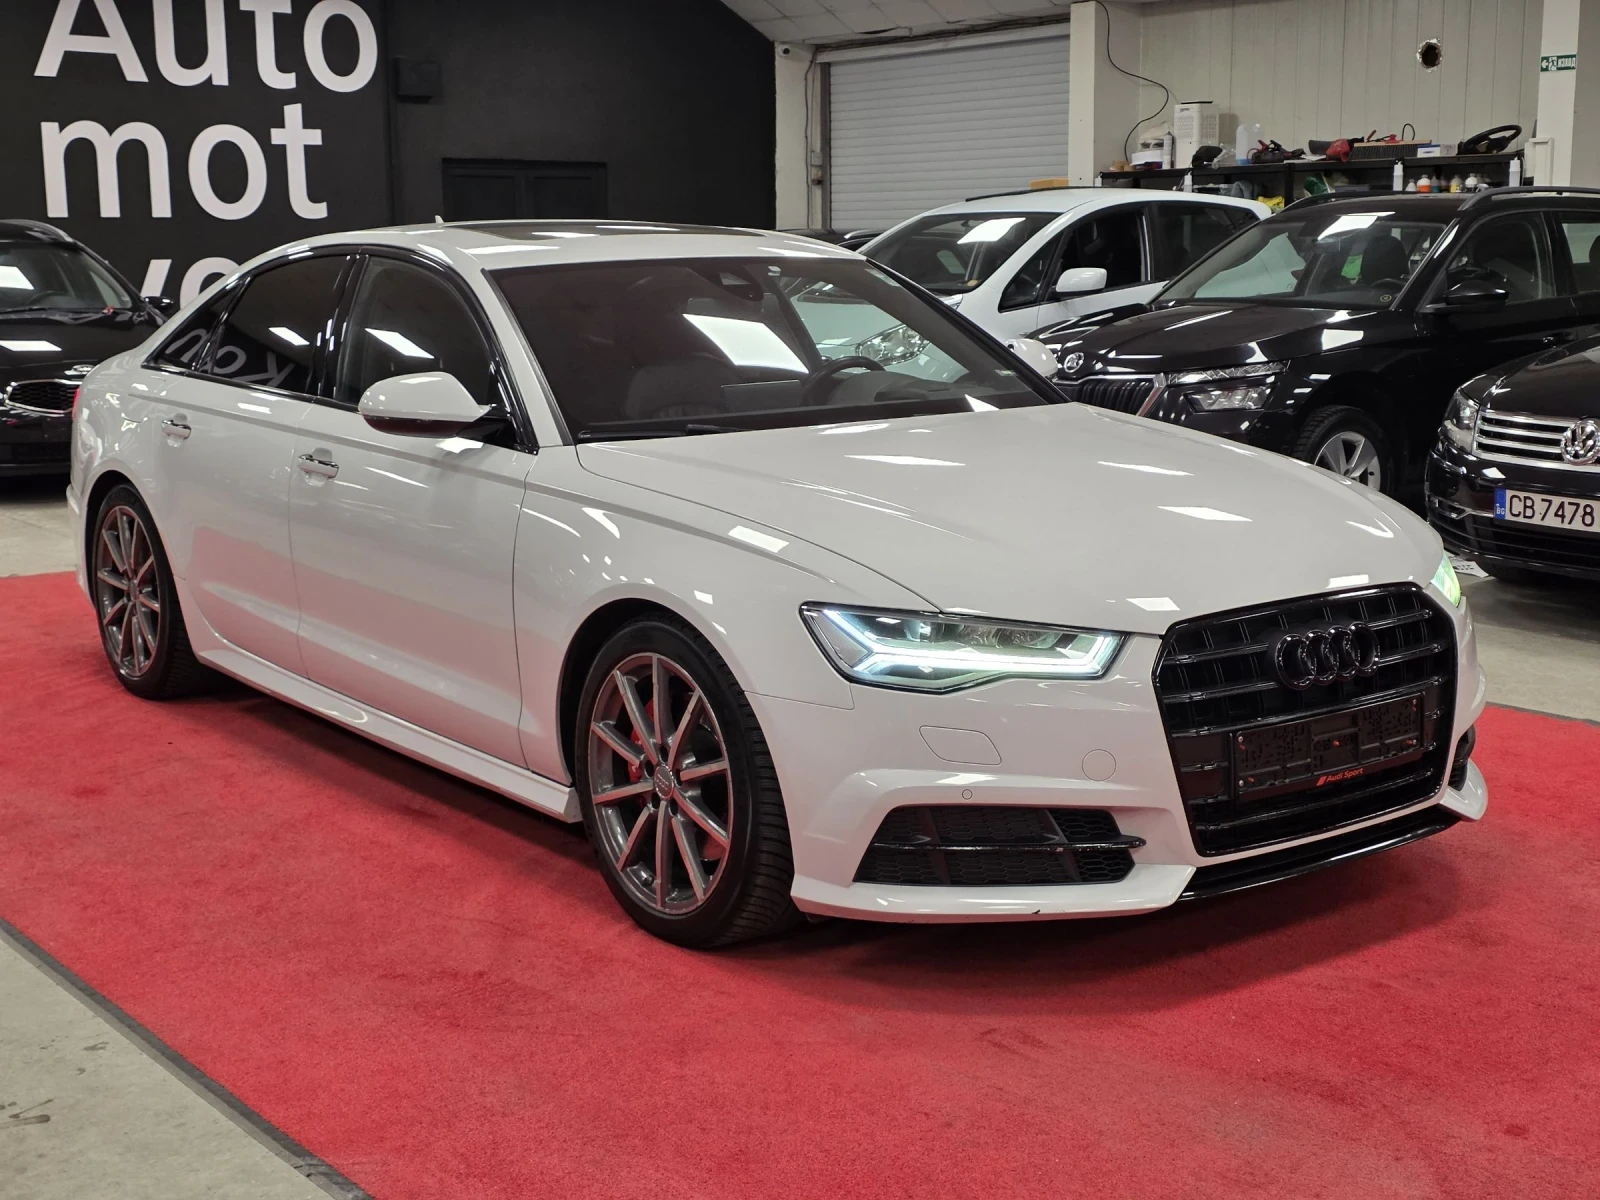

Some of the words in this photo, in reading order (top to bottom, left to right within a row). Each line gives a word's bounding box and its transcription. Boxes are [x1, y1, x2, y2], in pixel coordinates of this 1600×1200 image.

[34, 0, 378, 93] Auto
[41, 103, 328, 220] mot
[1327, 772, 1343, 782] Audi
[1344, 768, 1364, 778] Sport
